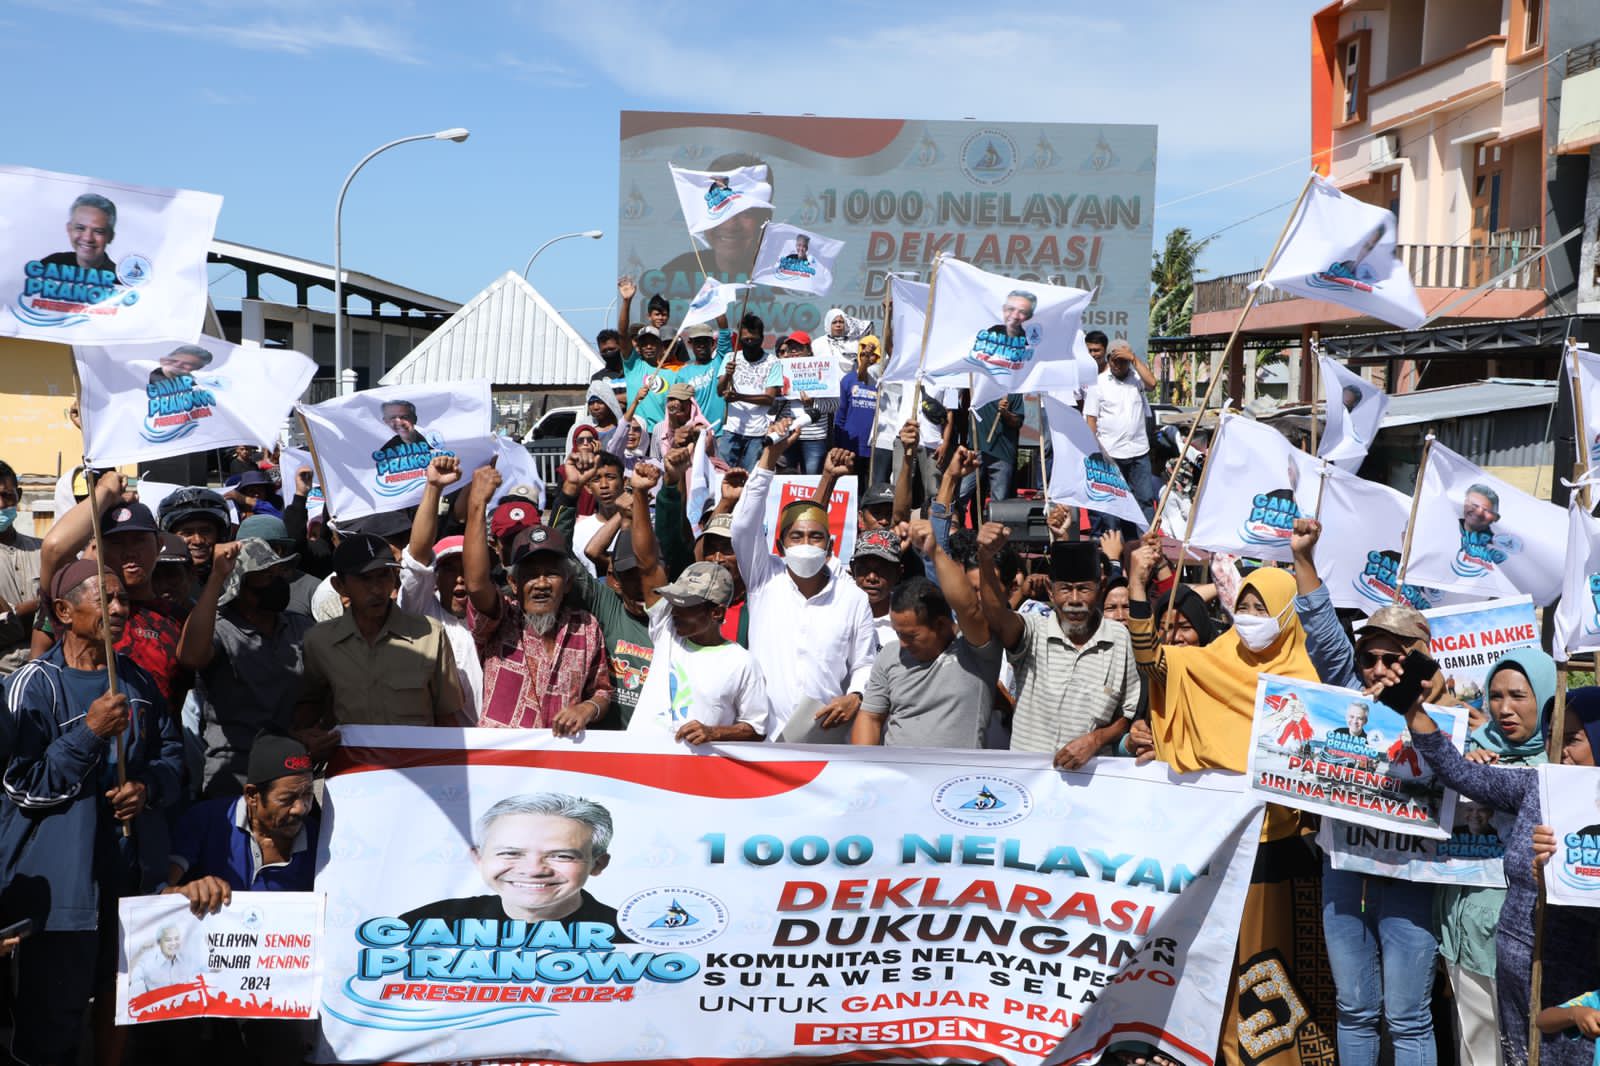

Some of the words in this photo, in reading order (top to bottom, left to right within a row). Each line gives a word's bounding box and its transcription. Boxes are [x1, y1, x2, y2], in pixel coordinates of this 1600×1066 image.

[820, 188, 923, 224] 1000
[939, 190, 1142, 229] NELAYAN
[867, 231, 1105, 270] DEKLARASI
[24, 260, 117, 288] GANJAR
[791, 361, 830, 369] NELAYAN
[372, 441, 430, 461] GANJAR
[1428, 633, 1476, 654] NGAI
[1480, 623, 1535, 647] NAKKE
[1444, 651, 1485, 670] GANJAR
[1288, 755, 1402, 794] PAENTENGI
[1330, 788, 1428, 821] NELAYAN
[700, 832, 874, 866] 1000
[1345, 827, 1428, 854] UNTUK
[776, 877, 1156, 937] DEKLARASI
[207, 933, 258, 948] NELAYAN
[264, 933, 312, 948] SENANG
[354, 916, 617, 951] GANJAR
[208, 954, 251, 969] GANJAR
[256, 954, 310, 969] MENANG
[357, 947, 701, 985] PRANOWO
[706, 950, 902, 968] KOMUNITAS
[912, 947, 1062, 977] NELAYAN
[240, 976, 271, 991] 2024
[703, 966, 954, 987] SULAWESI
[379, 983, 545, 1003] PRESIDEN
[548, 985, 637, 1003] 2024
[699, 996, 828, 1013] UNTUK
[841, 990, 989, 1013] GANJAR
[812, 1019, 987, 1042] PRESIDEN
